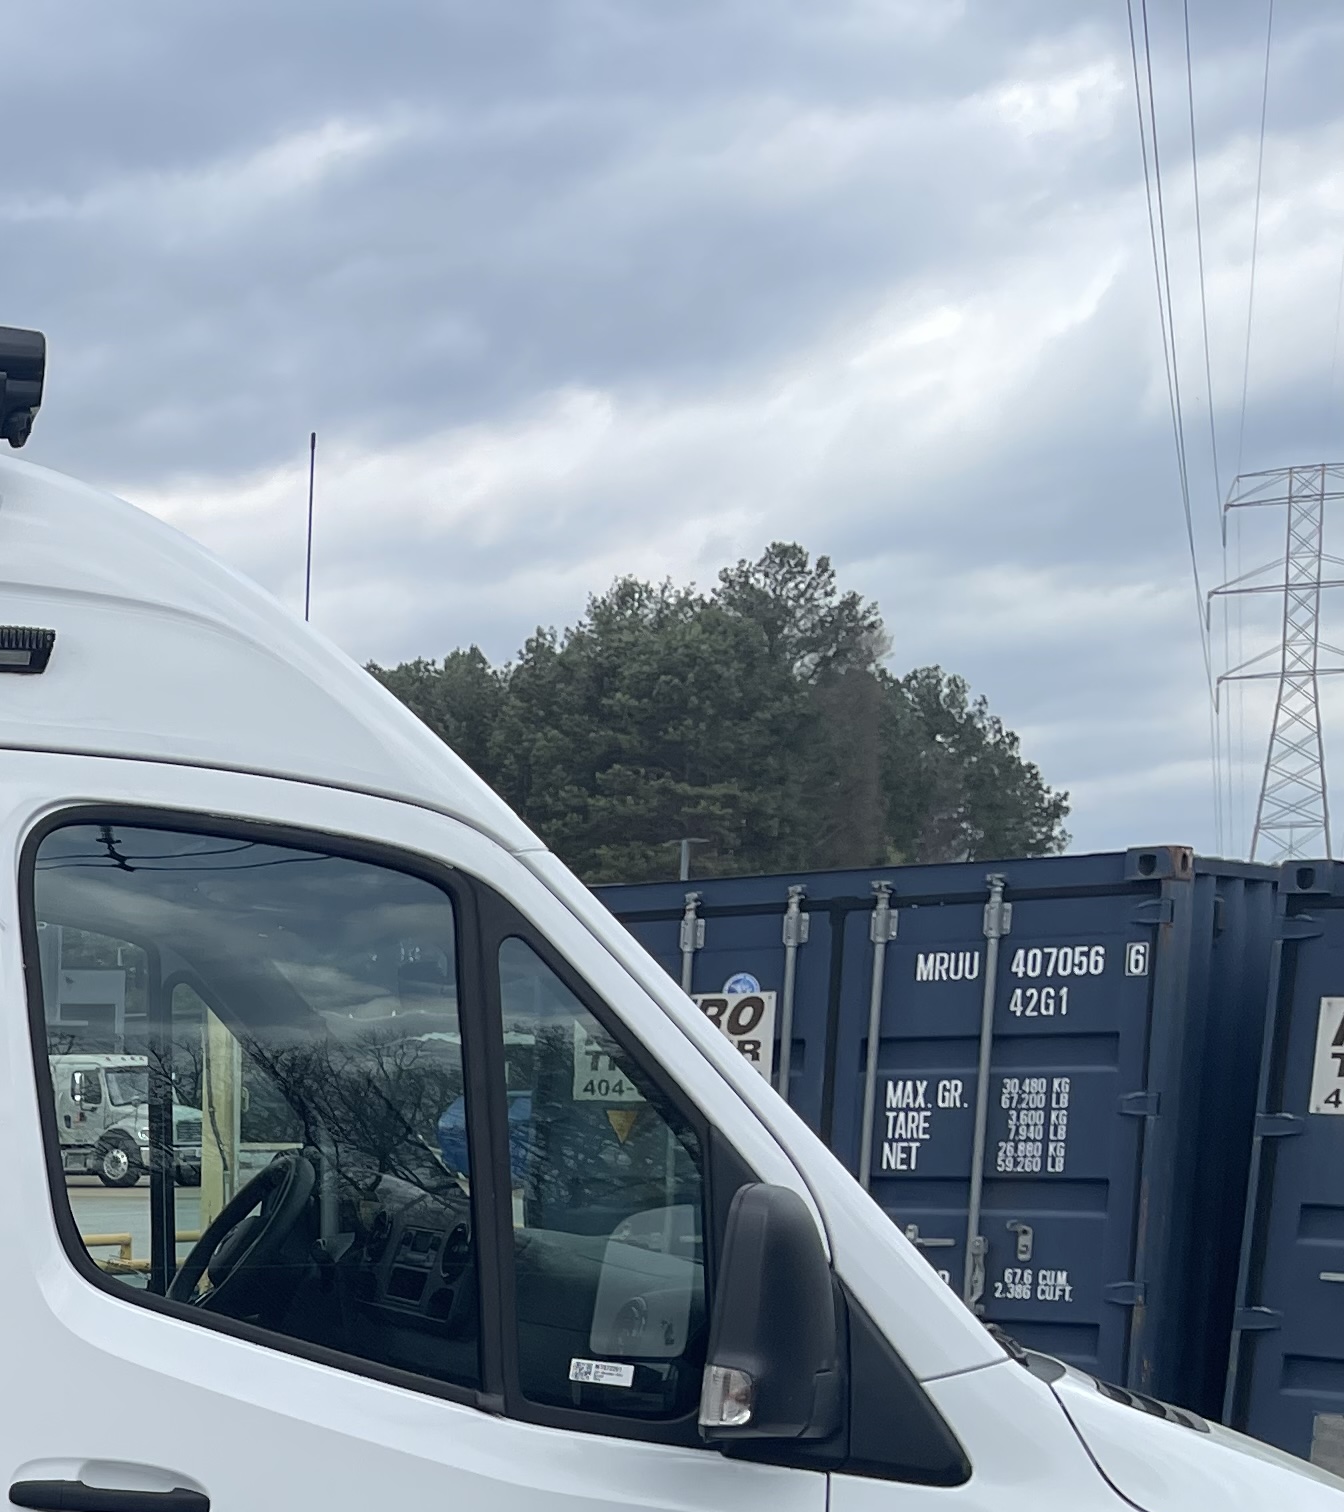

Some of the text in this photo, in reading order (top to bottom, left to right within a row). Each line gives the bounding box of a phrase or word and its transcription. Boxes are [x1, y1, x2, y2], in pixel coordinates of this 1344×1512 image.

[915, 944, 1147, 981] MRUU 407056 6
[1009, 986, 1068, 1016] 42G1
[886, 1077, 1070, 1108] MAX. GR. 30.480 KG
[1000, 1093, 1069, 1108] 67.200 LB
[886, 1109, 1068, 1139] TARE 3.600 KG
[1008, 1125, 1066, 1140] 7.940 LB
[881, 1142, 1066, 1170] NET 26.880 KG
[996, 1157, 1064, 1172] 59.260 LB
[1004, 1268, 1032, 1284] 67.6
[994, 1282, 1031, 1299] 2.386
